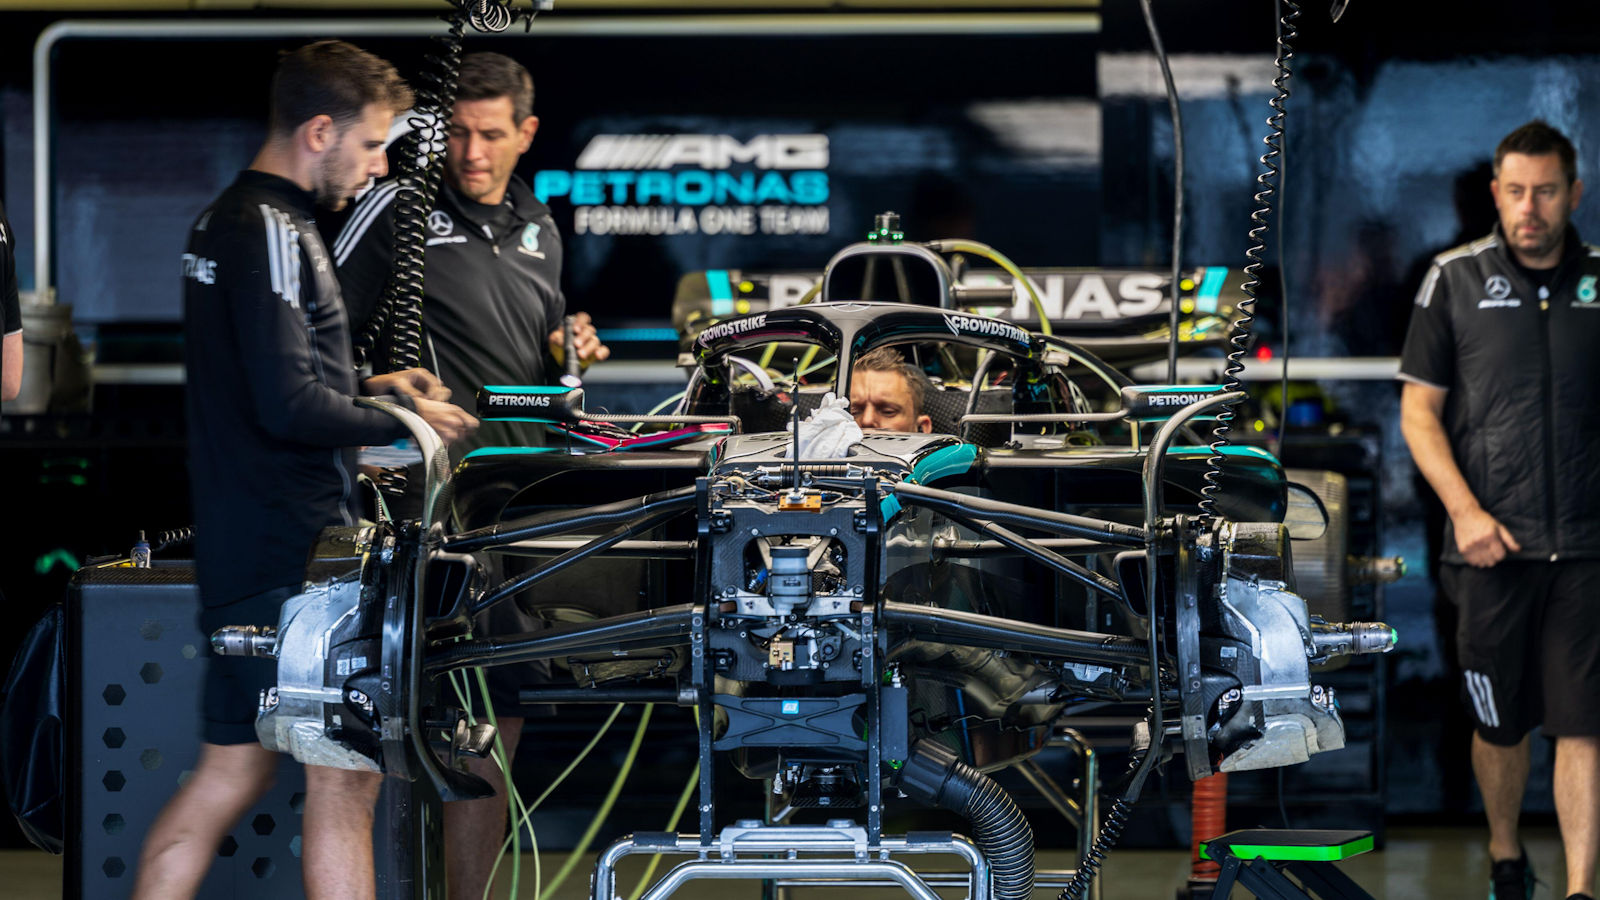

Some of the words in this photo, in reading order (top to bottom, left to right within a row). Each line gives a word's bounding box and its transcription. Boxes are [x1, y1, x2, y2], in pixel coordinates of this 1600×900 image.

[657, 134, 829, 169] AMG
[534, 170, 830, 205] PETRONAS
[574, 206, 698, 235] FORMULA
[700, 206, 756, 235] ONE
[760, 206, 829, 235] TEAM
[699, 314, 767, 342] CROWDSTRIKE
[951, 316, 1030, 344] CROWDSTRIKE
[488, 395, 551, 407] PETRONAS
